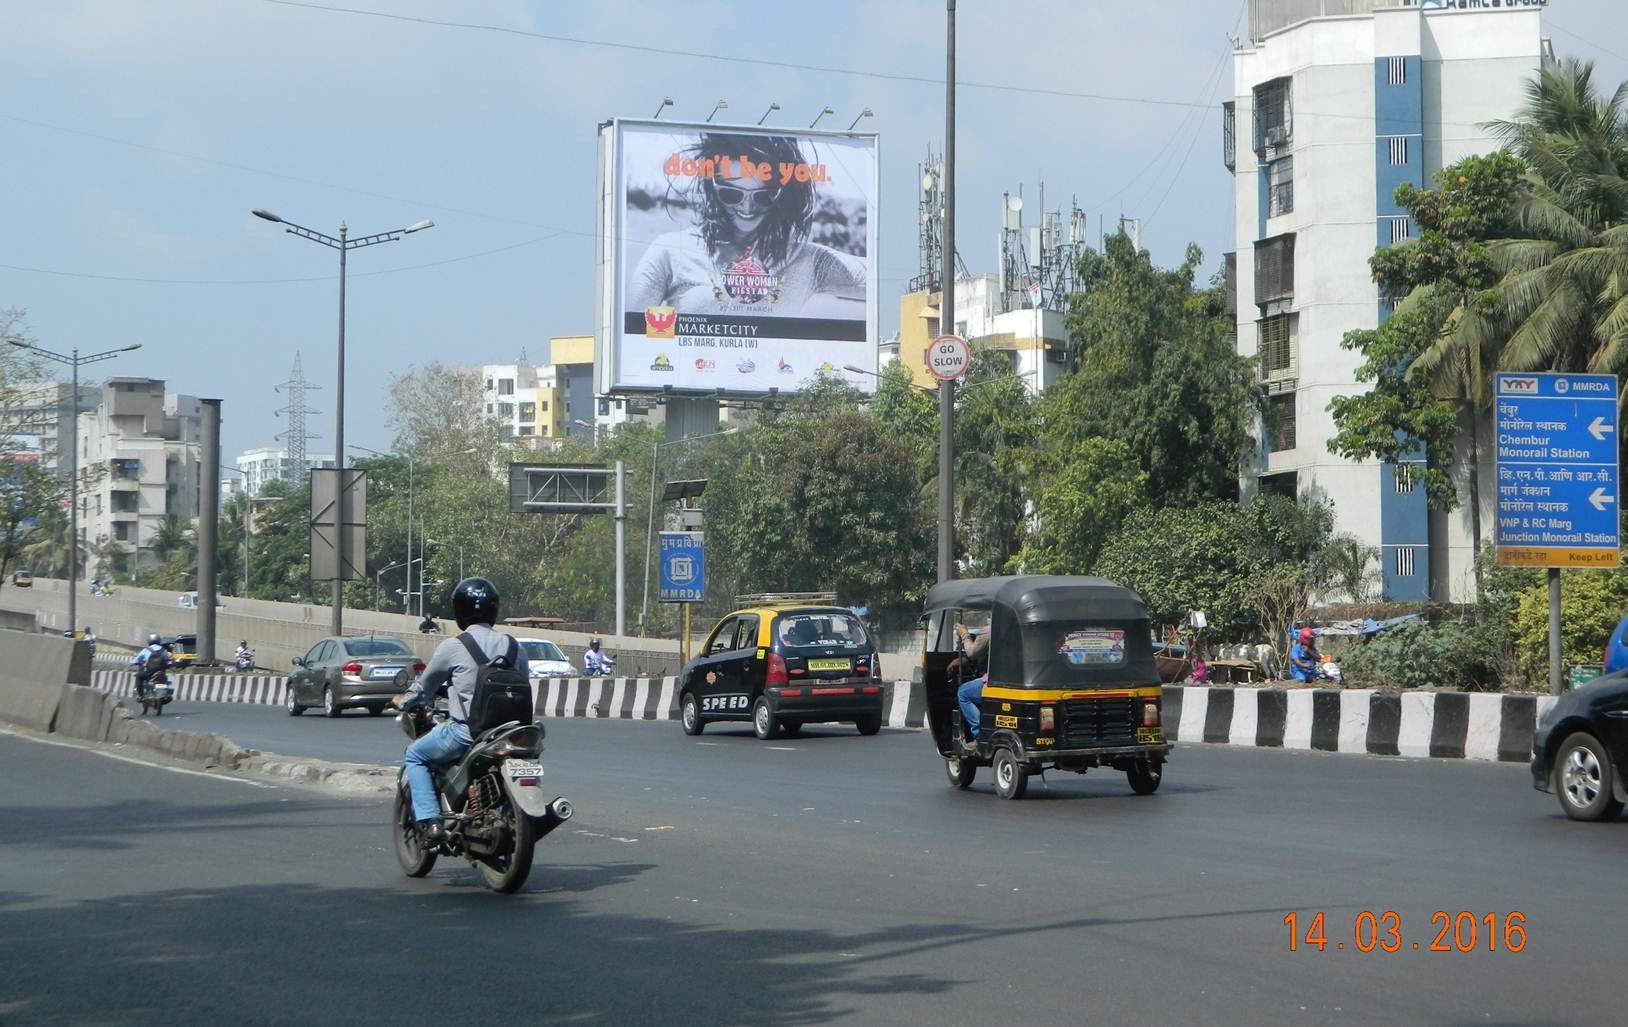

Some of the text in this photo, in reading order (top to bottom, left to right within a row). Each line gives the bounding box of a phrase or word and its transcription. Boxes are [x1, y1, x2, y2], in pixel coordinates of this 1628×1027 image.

[663, 153, 832, 186] don't be you.
[720, 275, 778, 287] OWER WOMAN
[678, 324, 758, 335] MARKETCITY
[679, 337, 692, 347] LBS
[719, 338, 743, 348] KURLA
[940, 345, 955, 354] GO
[934, 357, 963, 367] SLOW
[1573, 382, 1610, 392] MMRDA
[1500, 434, 1550, 445] Chembur
[1500, 447, 1590, 458] Monorail Station
[1500, 518, 1572, 530] VNP & RC Marg
[1500, 532, 1616, 543] Junction Monorail Station
[1569, 553, 1613, 562] Keep Left
[660, 588, 702, 599] MMRDA
[702, 695, 749, 711] SPEED
[1036, 737, 1056, 746] STOP
[510, 768, 542, 776] 7357
